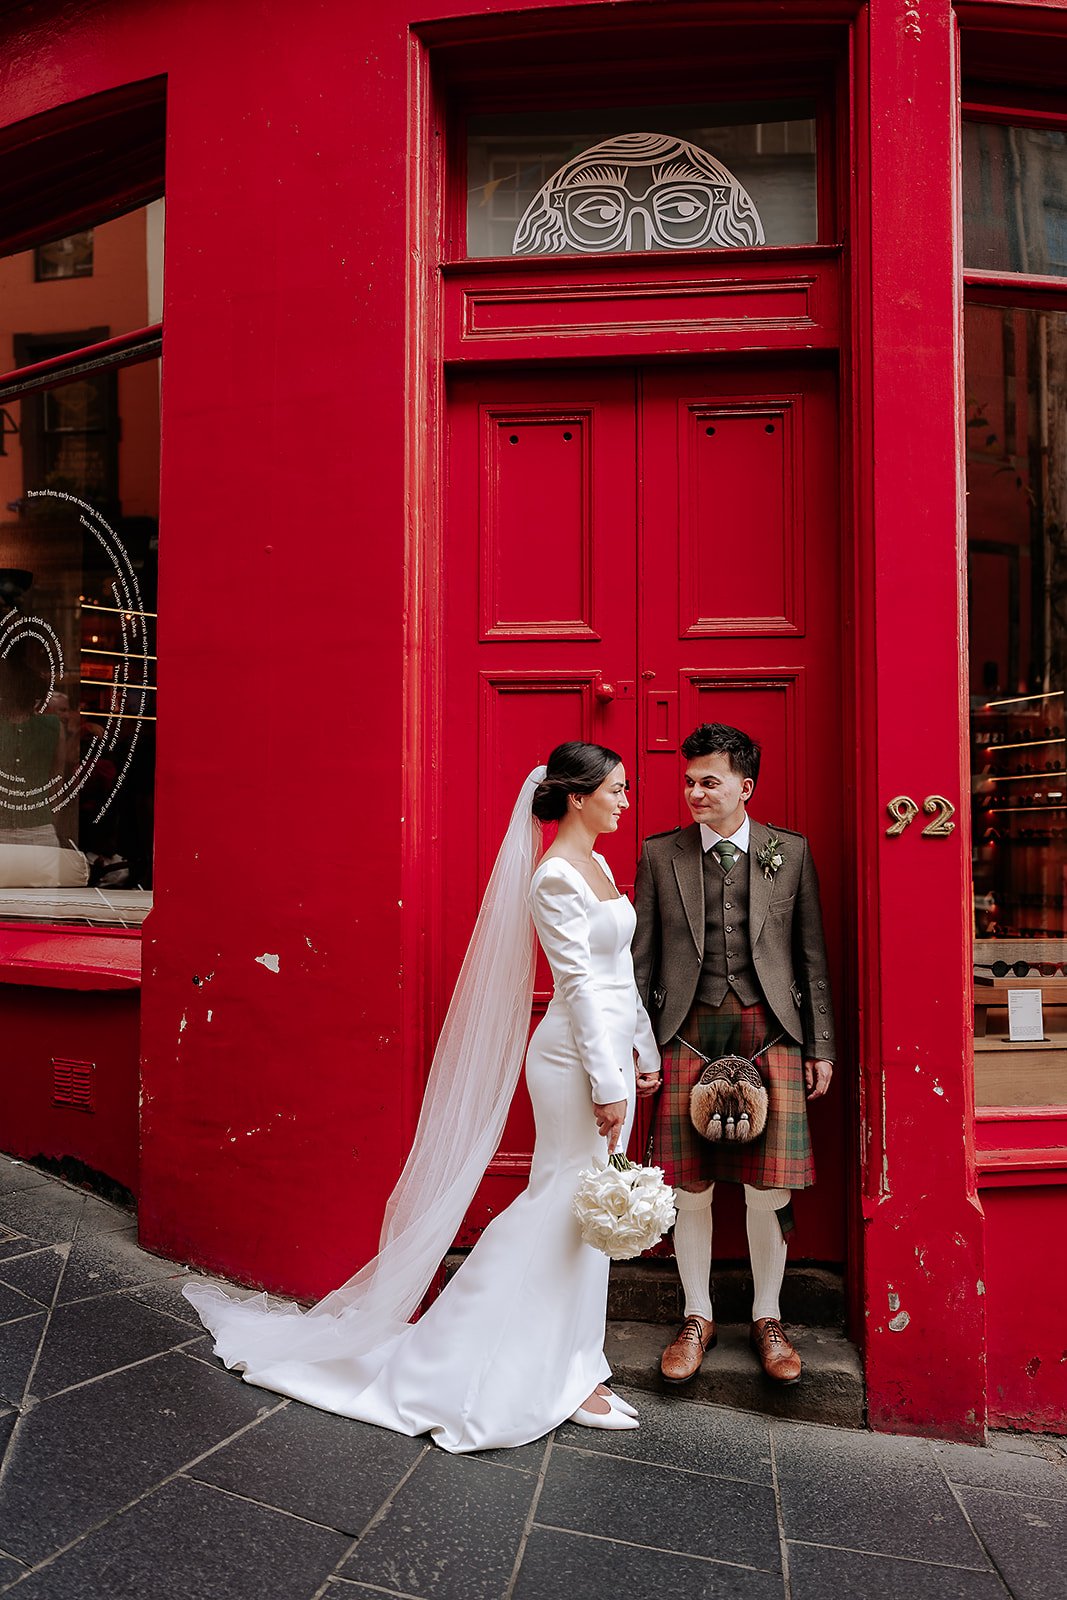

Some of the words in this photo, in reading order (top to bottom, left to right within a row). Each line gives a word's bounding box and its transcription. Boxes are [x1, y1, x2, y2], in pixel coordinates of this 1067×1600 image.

[79, 515, 90, 528] Then
[1, 644, 11, 659] Then
[886, 795, 956, 835] 92
